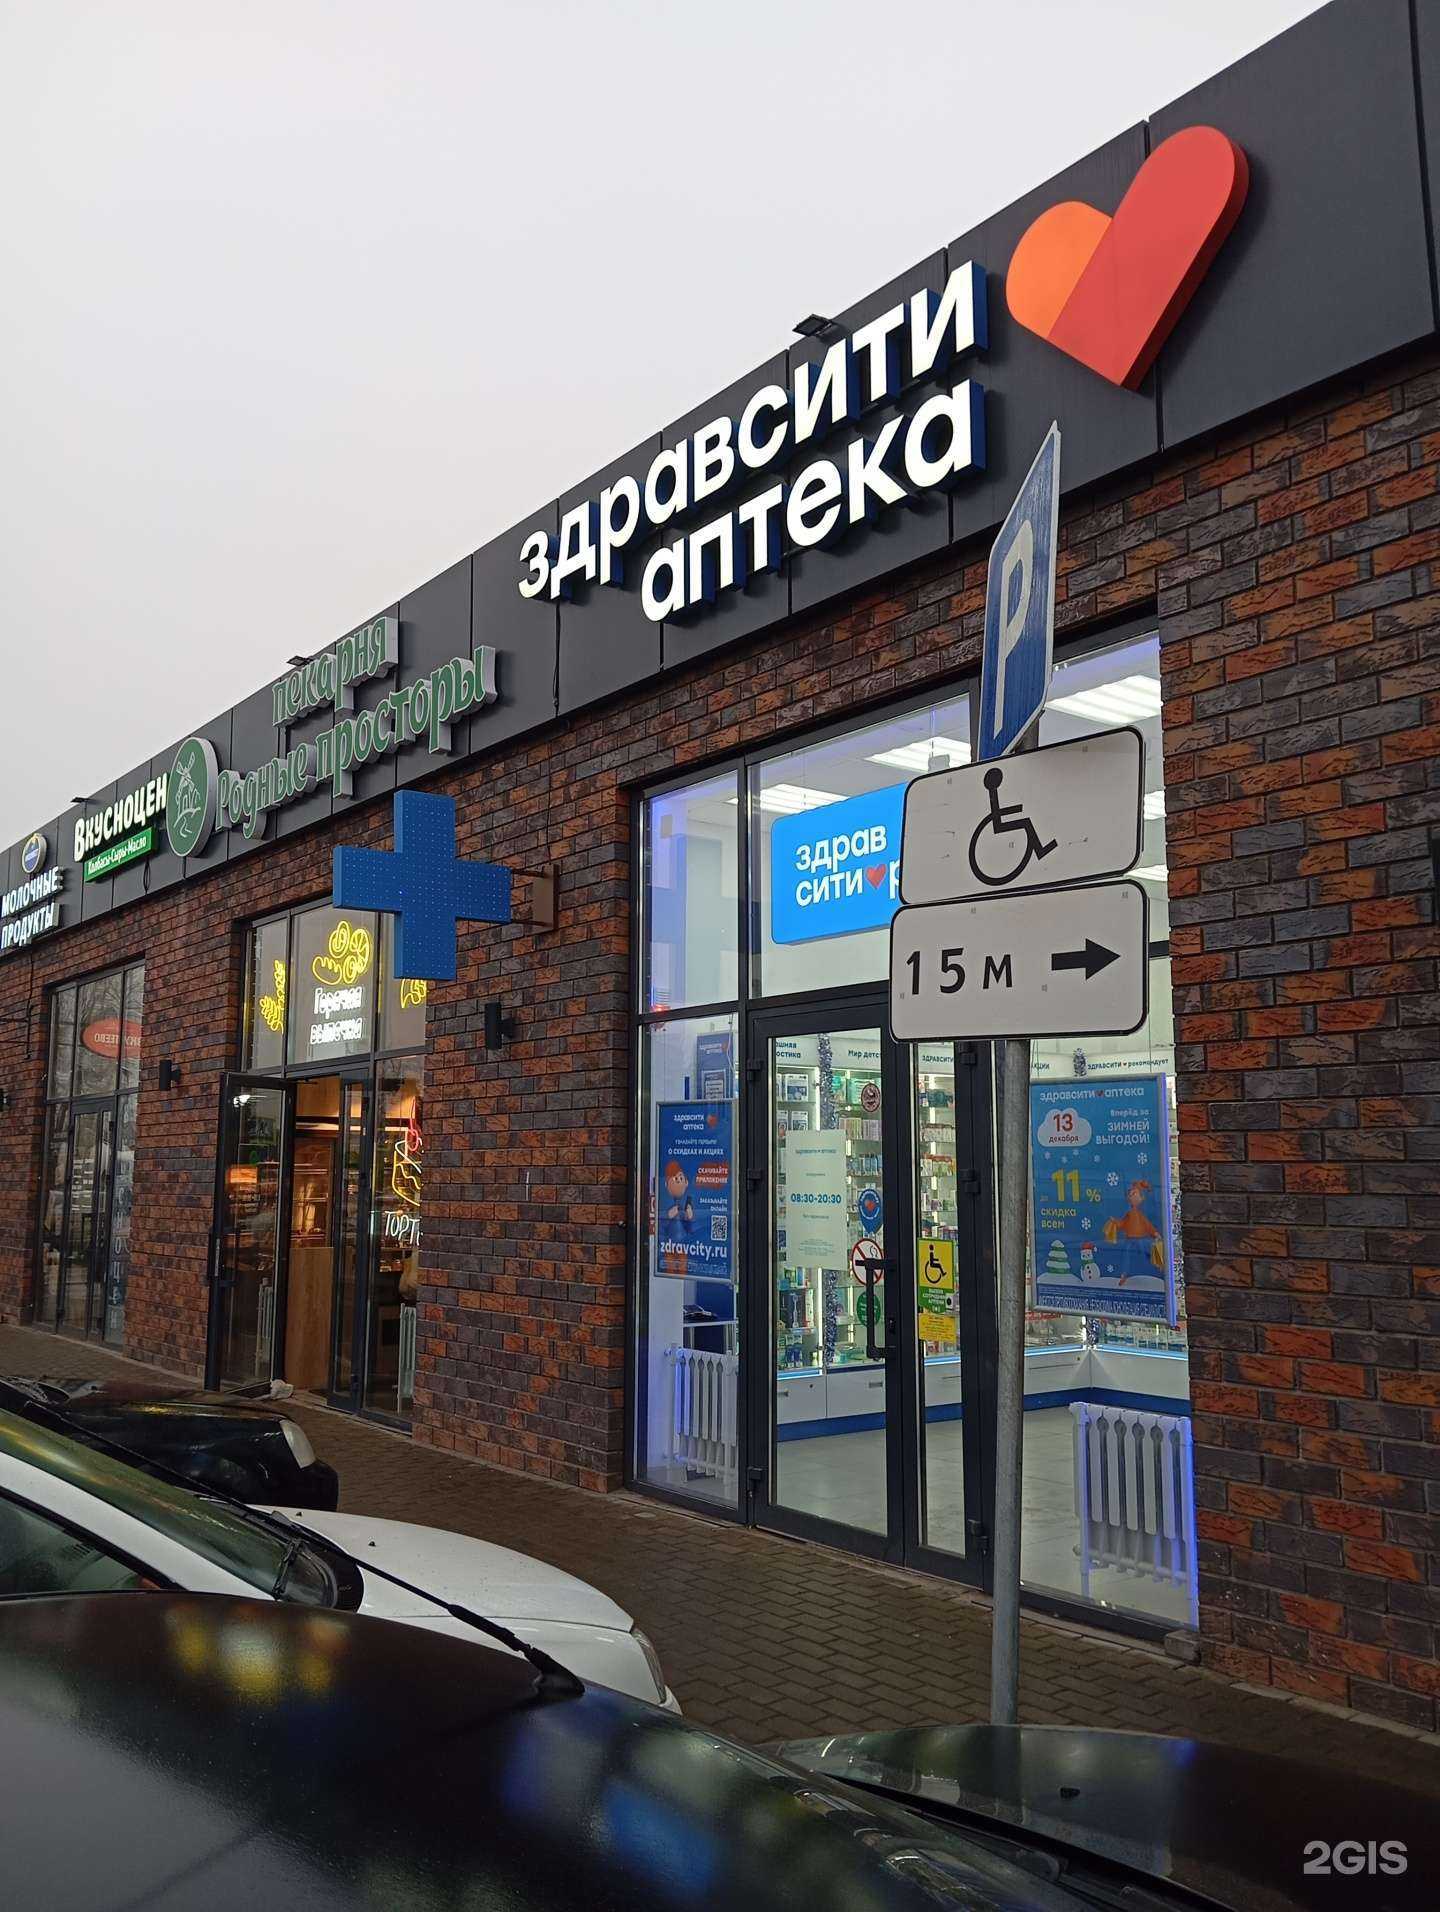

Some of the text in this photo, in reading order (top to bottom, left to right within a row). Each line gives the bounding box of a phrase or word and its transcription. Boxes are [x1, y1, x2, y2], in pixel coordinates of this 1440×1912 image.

[517, 259, 976, 601] здравсити
[641, 378, 975, 622] аптека
[272, 616, 392, 727] пекарня
[315, 645, 490, 798] просторы
[795, 824, 888, 871] здрав
[1, 866, 60, 919] МОЛОЧНЫЕ
[795, 871, 864, 907] сити
[1, 902, 56, 950] ПРОДУКТЫ
[905, 947, 966, 996] 15
[1040, 1087, 1145, 1103] здравсити аптека
[1053, 1113, 1074, 1133] 13
[1107, 1117, 1150, 1132] ЗИМНЕЙ
[1048, 1134, 1079, 1144] декабря
[1095, 1131, 1150, 1146] ВЫГОДОЙ!
[790, 1193, 842, 1204] 08:30-20:30
[1040, 1207, 1077, 1218] скидка
[1041, 1219, 1065, 1229] всем
[660, 1239, 728, 1262] zdravcity.ru
